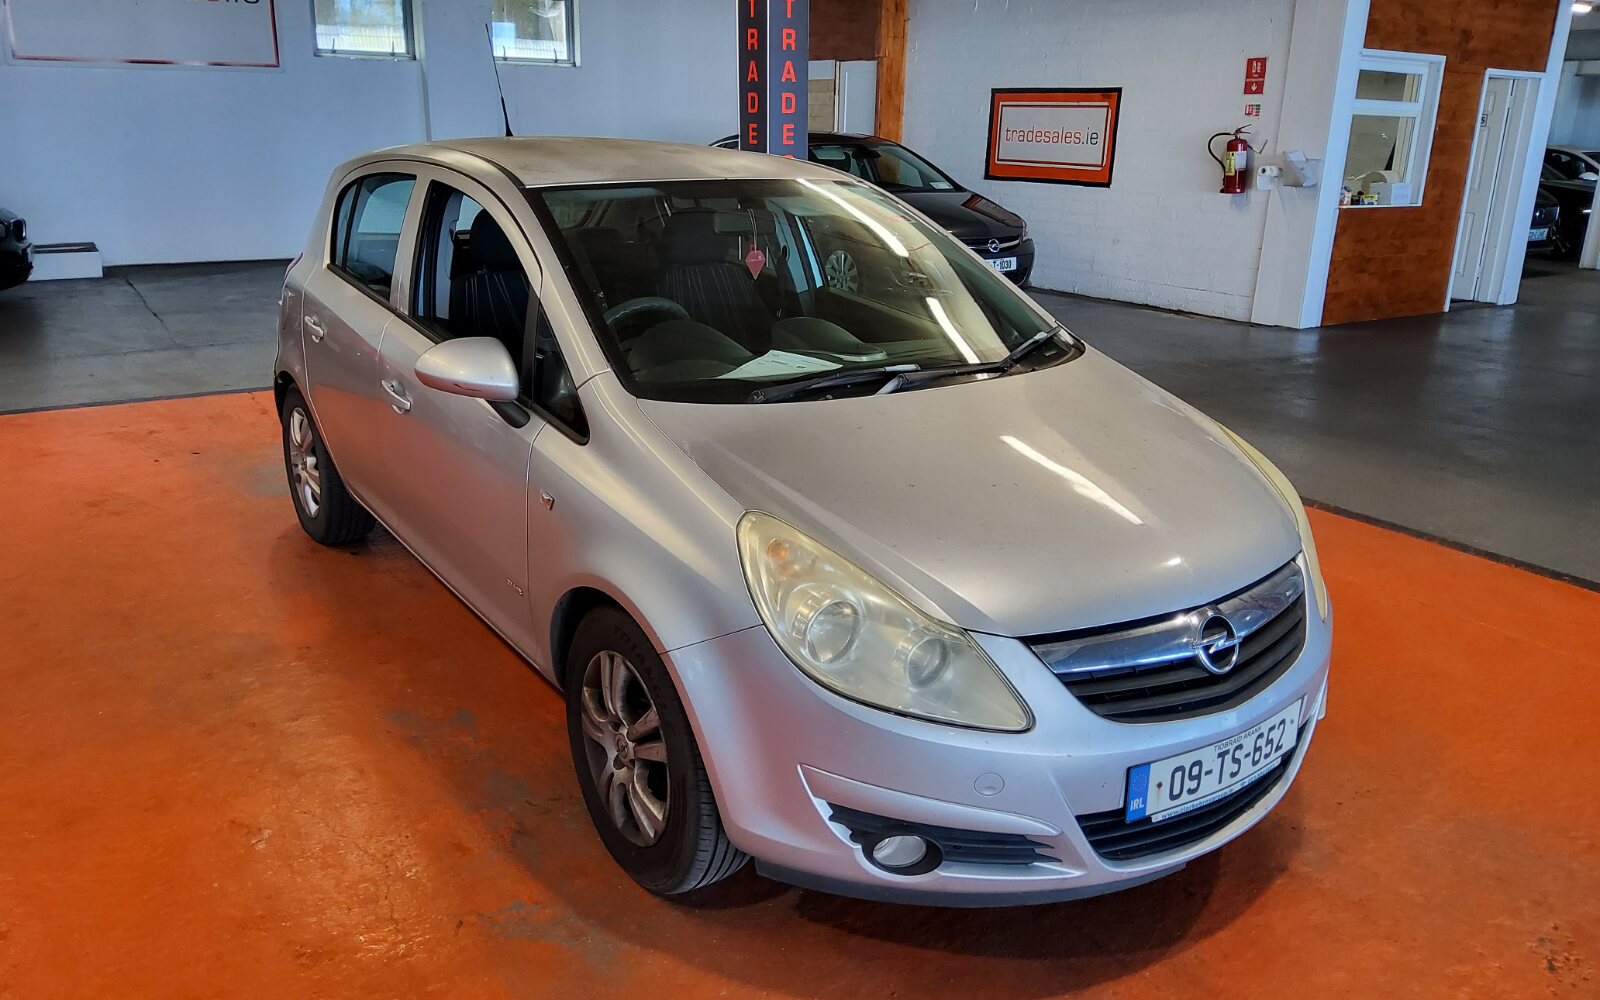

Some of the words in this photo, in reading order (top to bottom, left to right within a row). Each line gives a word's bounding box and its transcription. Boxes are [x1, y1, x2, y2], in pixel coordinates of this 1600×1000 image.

[747, 0, 759, 145] TRADE
[781, 0, 797, 158] TRADE
[1005, 125, 1099, 146] tradesales.ie
[1129, 797, 1145, 812] IRL
[1168, 718, 1286, 802] 09-TS-652
[1214, 735, 1243, 752] TIOBRAID
